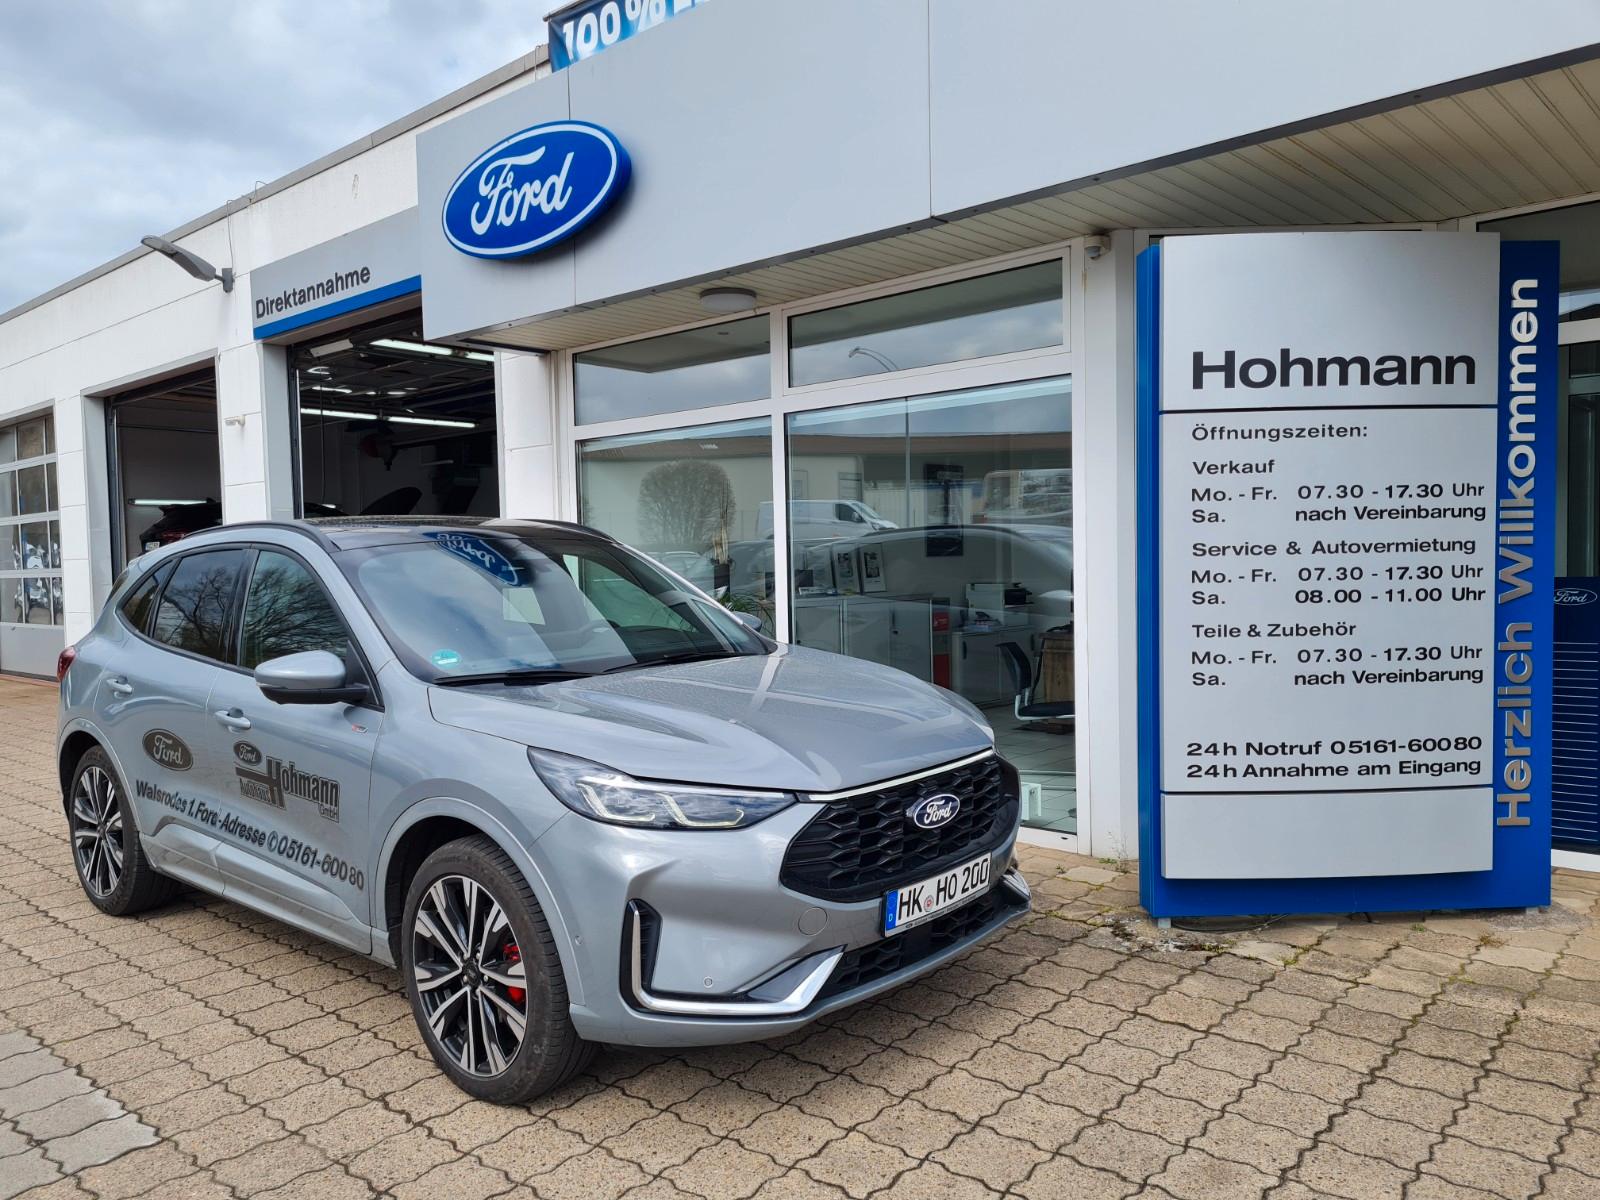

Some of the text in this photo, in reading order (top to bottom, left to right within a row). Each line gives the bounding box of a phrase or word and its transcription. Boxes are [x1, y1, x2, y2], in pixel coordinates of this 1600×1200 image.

[470, 145, 575, 236] Ford
[254, 264, 371, 319] Direktannahme
[1193, 348, 1477, 389] Hohmann
[1191, 423, 1368, 443] Öffnungszeiten:
[1191, 459, 1276, 475] Verkauf
[1297, 484, 1364, 500] 07.30
[1384, 483, 1444, 499] 17.30
[1452, 482, 1485, 497] Uhr
[1191, 504, 1487, 524] Sa. nach Vereinbarung
[1192, 538, 1476, 557] Service & Autovermietung
[1496, 278, 1538, 827] Herzlich Willkommen
[1298, 566, 1364, 582] 07.30
[1384, 565, 1444, 581] 17.30
[1451, 564, 1484, 579] Uhr
[1191, 590, 1226, 606] Sa.
[1294, 588, 1362, 604] 08.00
[1384, 587, 1443, 603] 11.00
[1451, 586, 1487, 602] Uhr
[1554, 590, 1588, 602] Ford
[1191, 621, 1357, 639] Teile & Zubehör
[1297, 647, 1363, 664] 07.30
[1383, 646, 1442, 662] 17.30
[1450, 645, 1483, 660] Uhr
[1192, 668, 1484, 687] Sa. nach Vereinbarung
[153, 735, 183, 765] Ford
[239, 744, 257, 761] Ford
[1245, 740, 1323, 756] Notruf
[1241, 762, 1350, 778] Annahme
[1357, 764, 1391, 777] am
[1398, 759, 1481, 777] Eingang
[266, 756, 339, 809] Hohmann
[136, 779, 187, 813] Walsrodes
[319, 804, 339, 820] GmbH
[924, 801, 952, 824] Ford
[898, 885, 924, 920] HK
[936, 873, 957, 906] HO
[961, 858, 989, 894] 200
